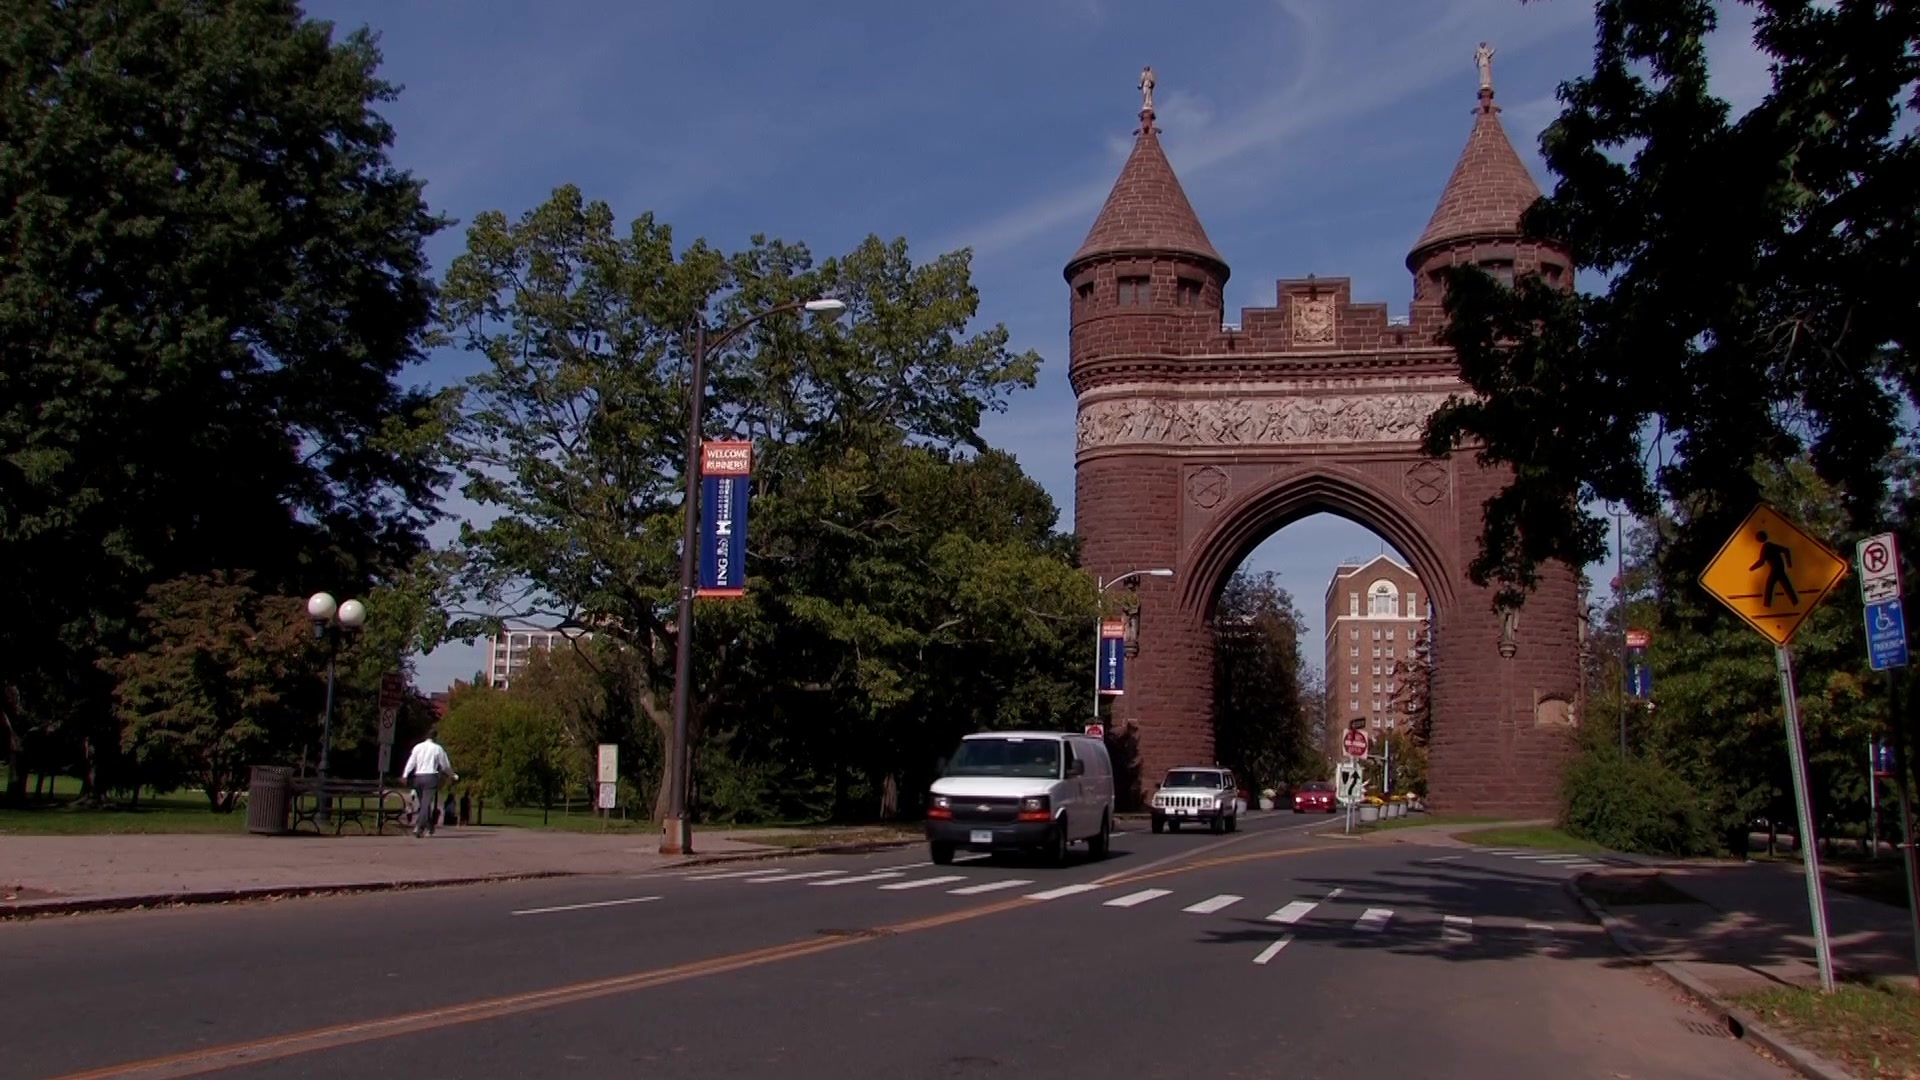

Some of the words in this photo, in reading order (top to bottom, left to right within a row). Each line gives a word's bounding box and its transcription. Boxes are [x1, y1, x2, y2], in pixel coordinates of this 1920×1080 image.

[707, 449, 748, 459] WELCOME
[706, 459, 748, 470] RUNNERS!
[717, 558, 728, 586] ING
